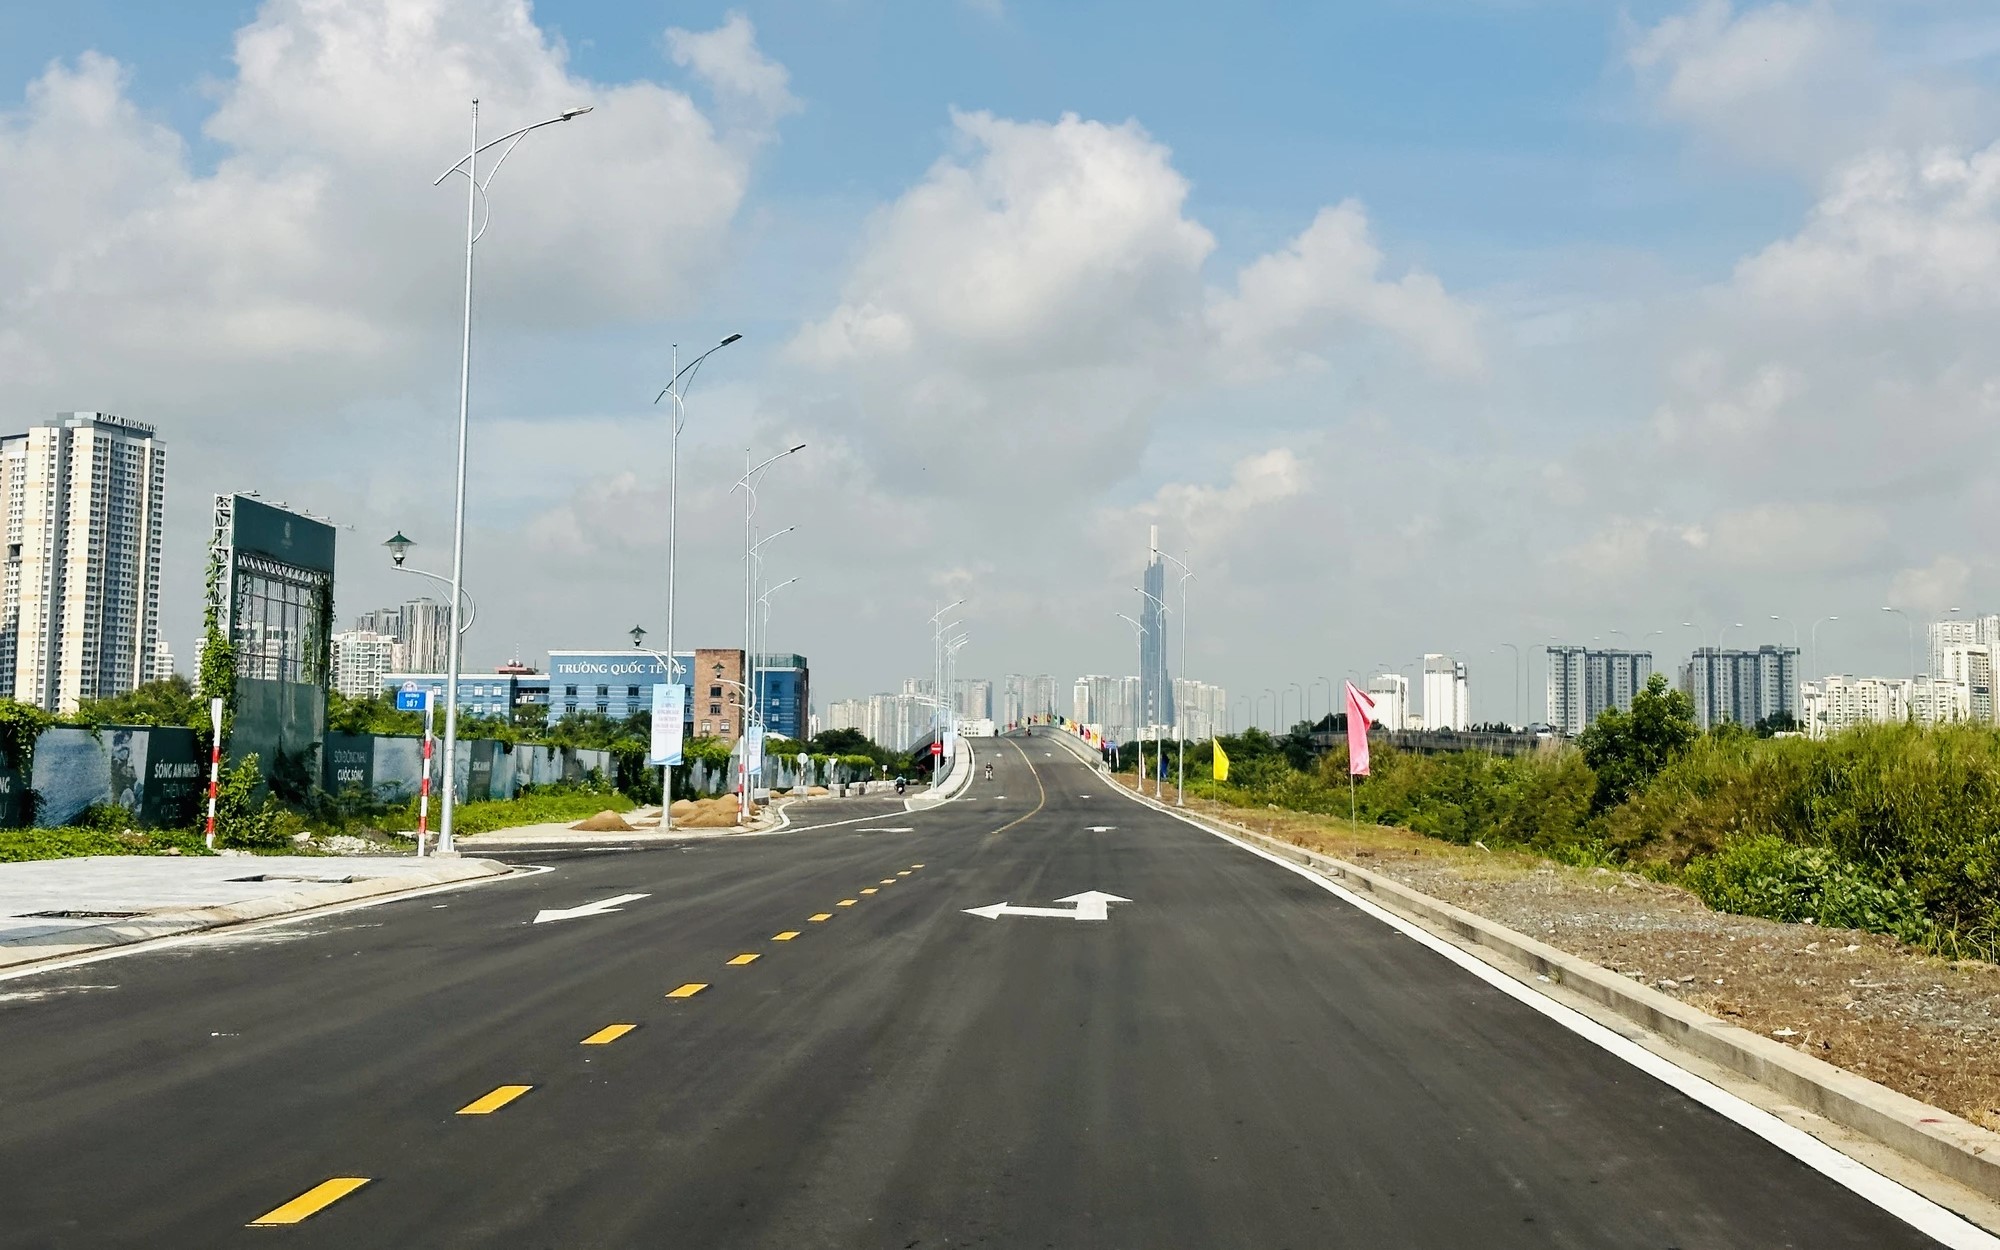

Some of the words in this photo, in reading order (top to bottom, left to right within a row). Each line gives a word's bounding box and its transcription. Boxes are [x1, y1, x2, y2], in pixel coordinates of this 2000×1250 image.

[557, 661, 608, 674] TRƯỜNG
[610, 660, 646, 676] QUỐC
[154, 759, 173, 779] SỐNG
